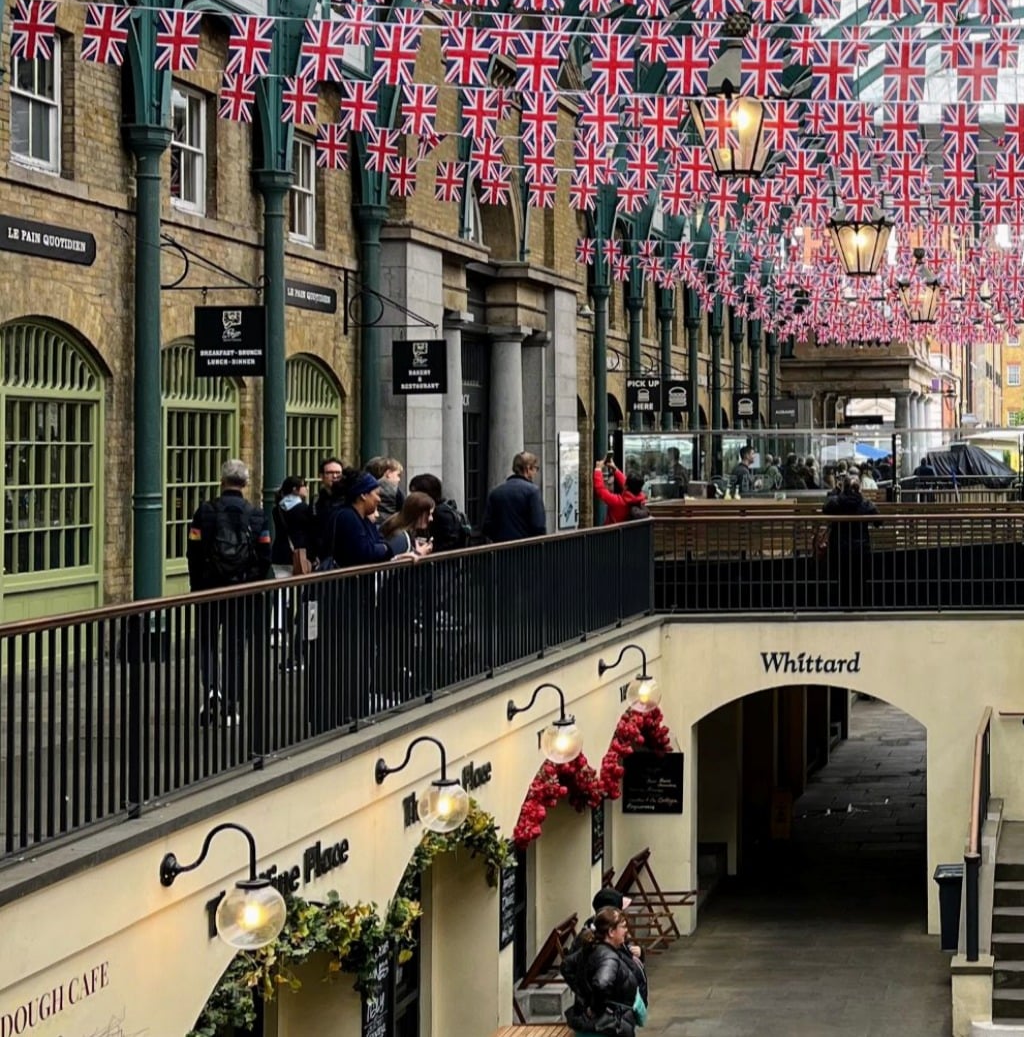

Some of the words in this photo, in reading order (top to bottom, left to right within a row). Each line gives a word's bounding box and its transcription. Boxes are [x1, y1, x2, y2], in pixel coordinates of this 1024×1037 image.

[8, 227, 19, 239] LE
[21, 230, 41, 243] PAIN
[43, 234, 86, 253] QUOTIDIEN
[627, 379, 647, 388] PICK
[648, 379, 660, 388] UP
[633, 402, 654, 411] HERE
[760, 651, 861, 673] Whittard
[303, 838, 349, 884] Place
[1, 984, 64, 1037] DOUGH
[68, 961, 110, 1005] CAFE
